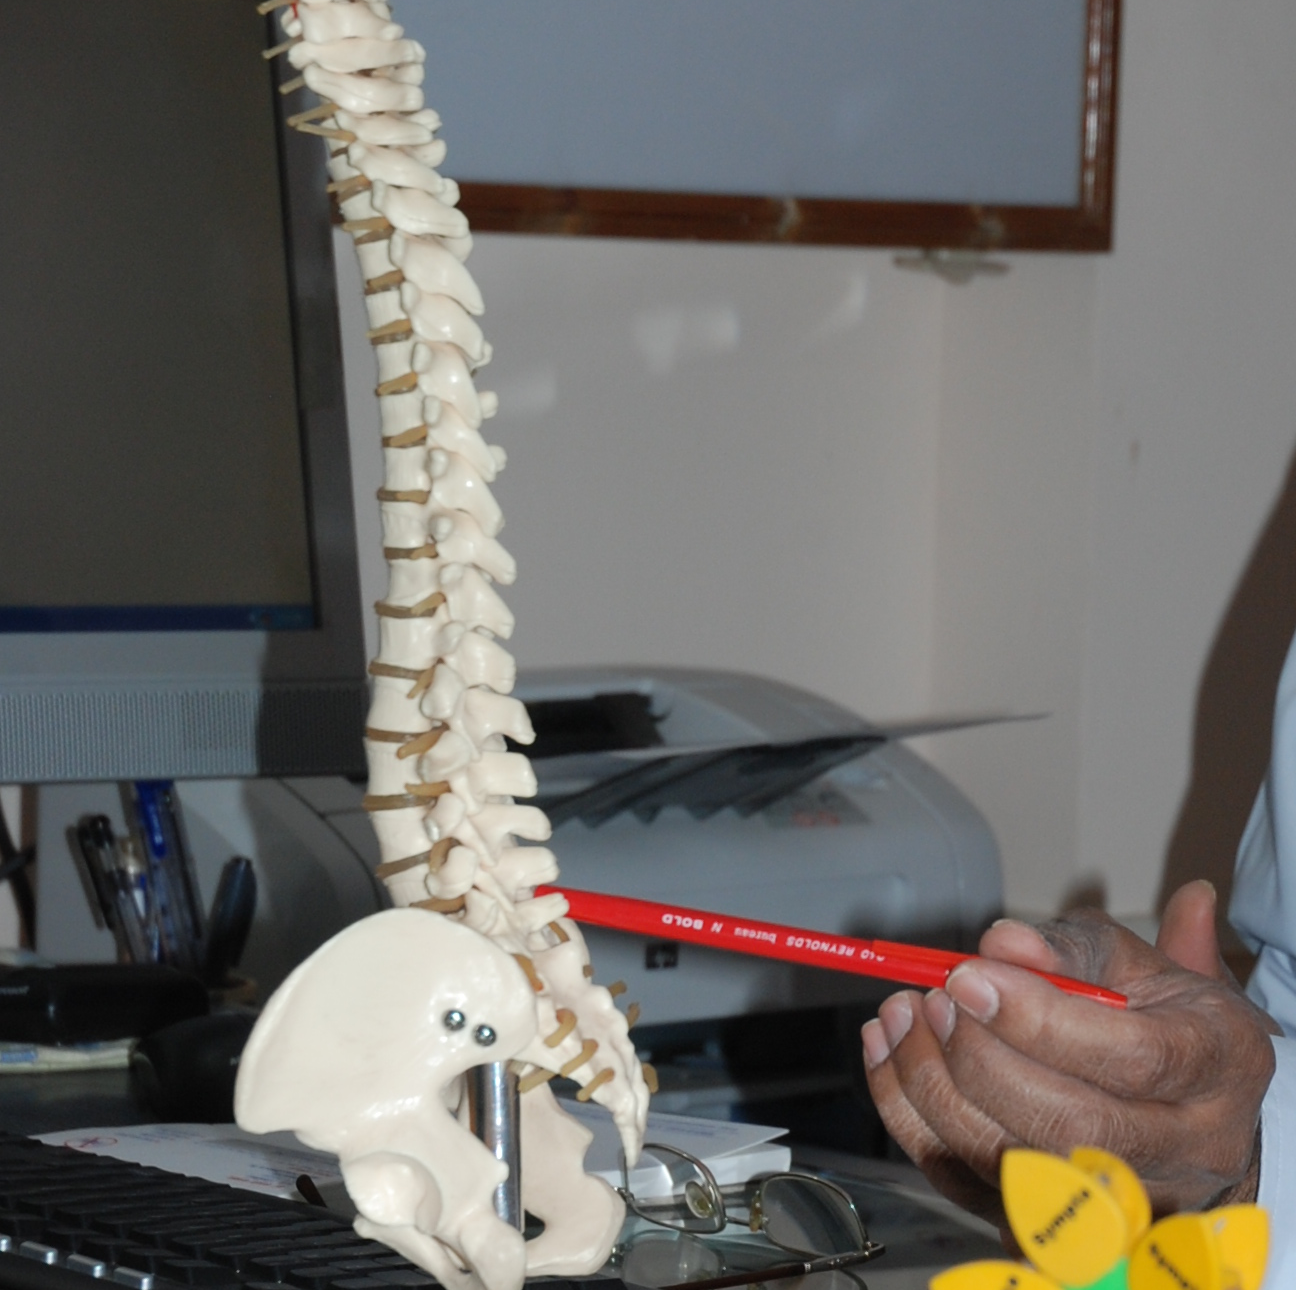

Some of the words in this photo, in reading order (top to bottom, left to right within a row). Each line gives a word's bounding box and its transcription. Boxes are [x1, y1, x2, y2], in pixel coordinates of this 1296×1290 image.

[661, 913, 704, 930] BOLD
[710, 921, 723, 933] N
[734, 926, 777, 943] bureau
[786, 936, 855, 958] REYNOLDS
